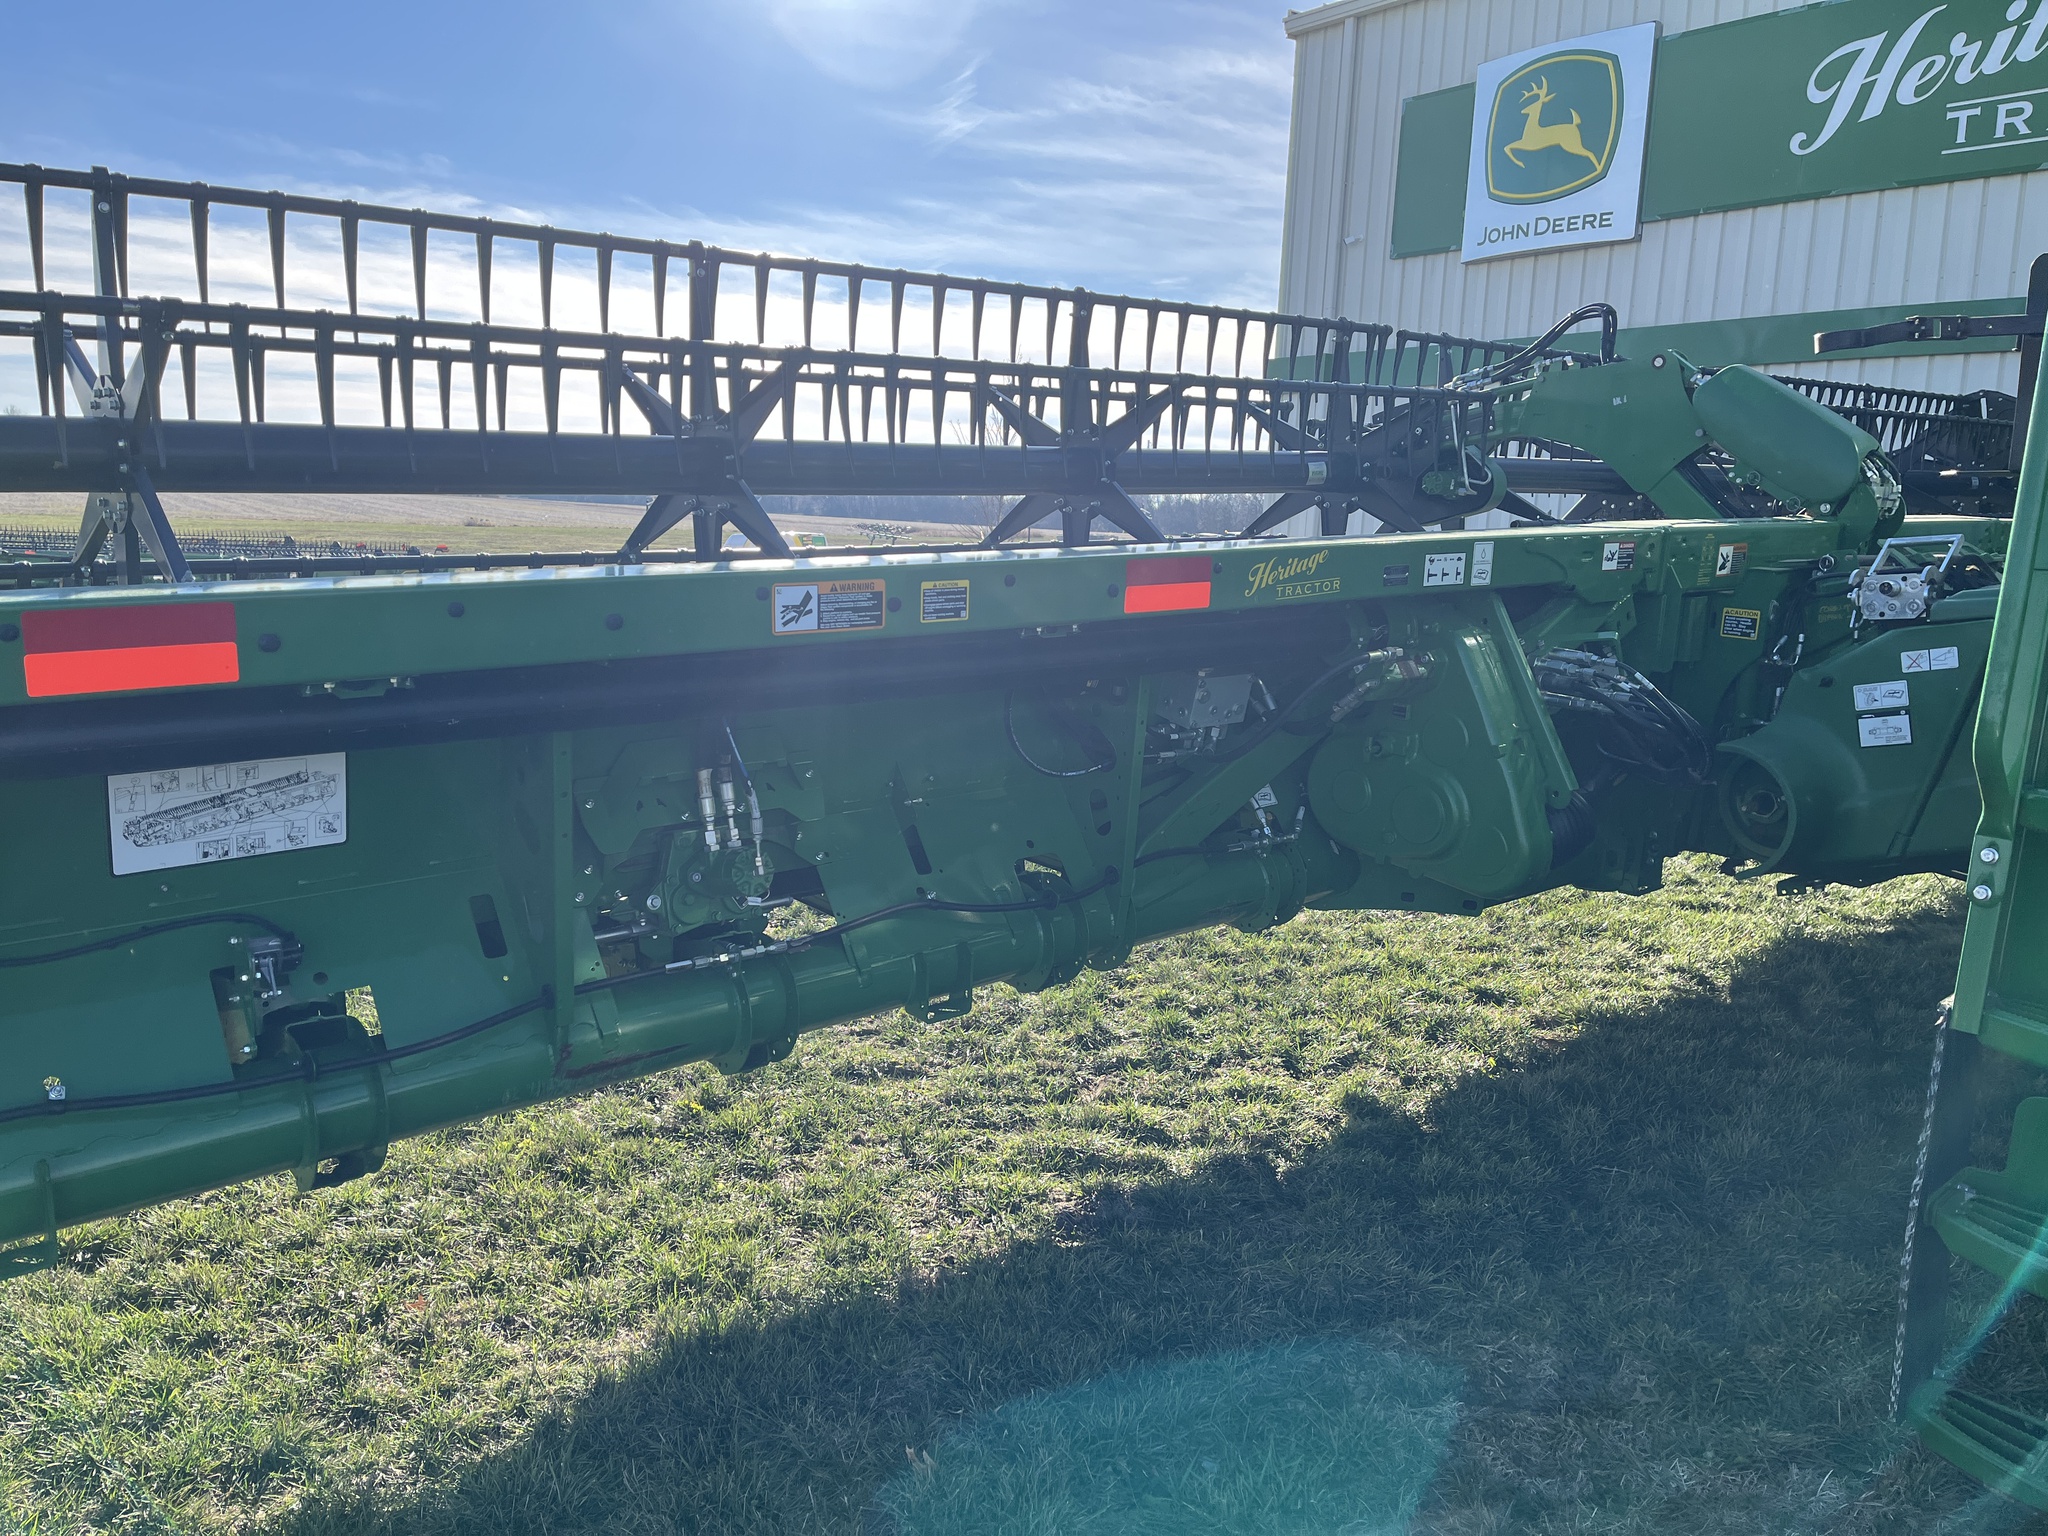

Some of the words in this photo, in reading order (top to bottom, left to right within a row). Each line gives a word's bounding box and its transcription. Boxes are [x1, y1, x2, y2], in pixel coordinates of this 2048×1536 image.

[1946, 101, 2048, 144] TR
[1477, 222, 1530, 247] JOHN
[1534, 211, 1614, 237] DEERE
[838, 582, 875, 592] WARNING
[1244, 549, 1329, 598] Heritage
[1276, 580, 1341, 598] TRACTOR
[1730, 609, 1759, 617] CAUTION
